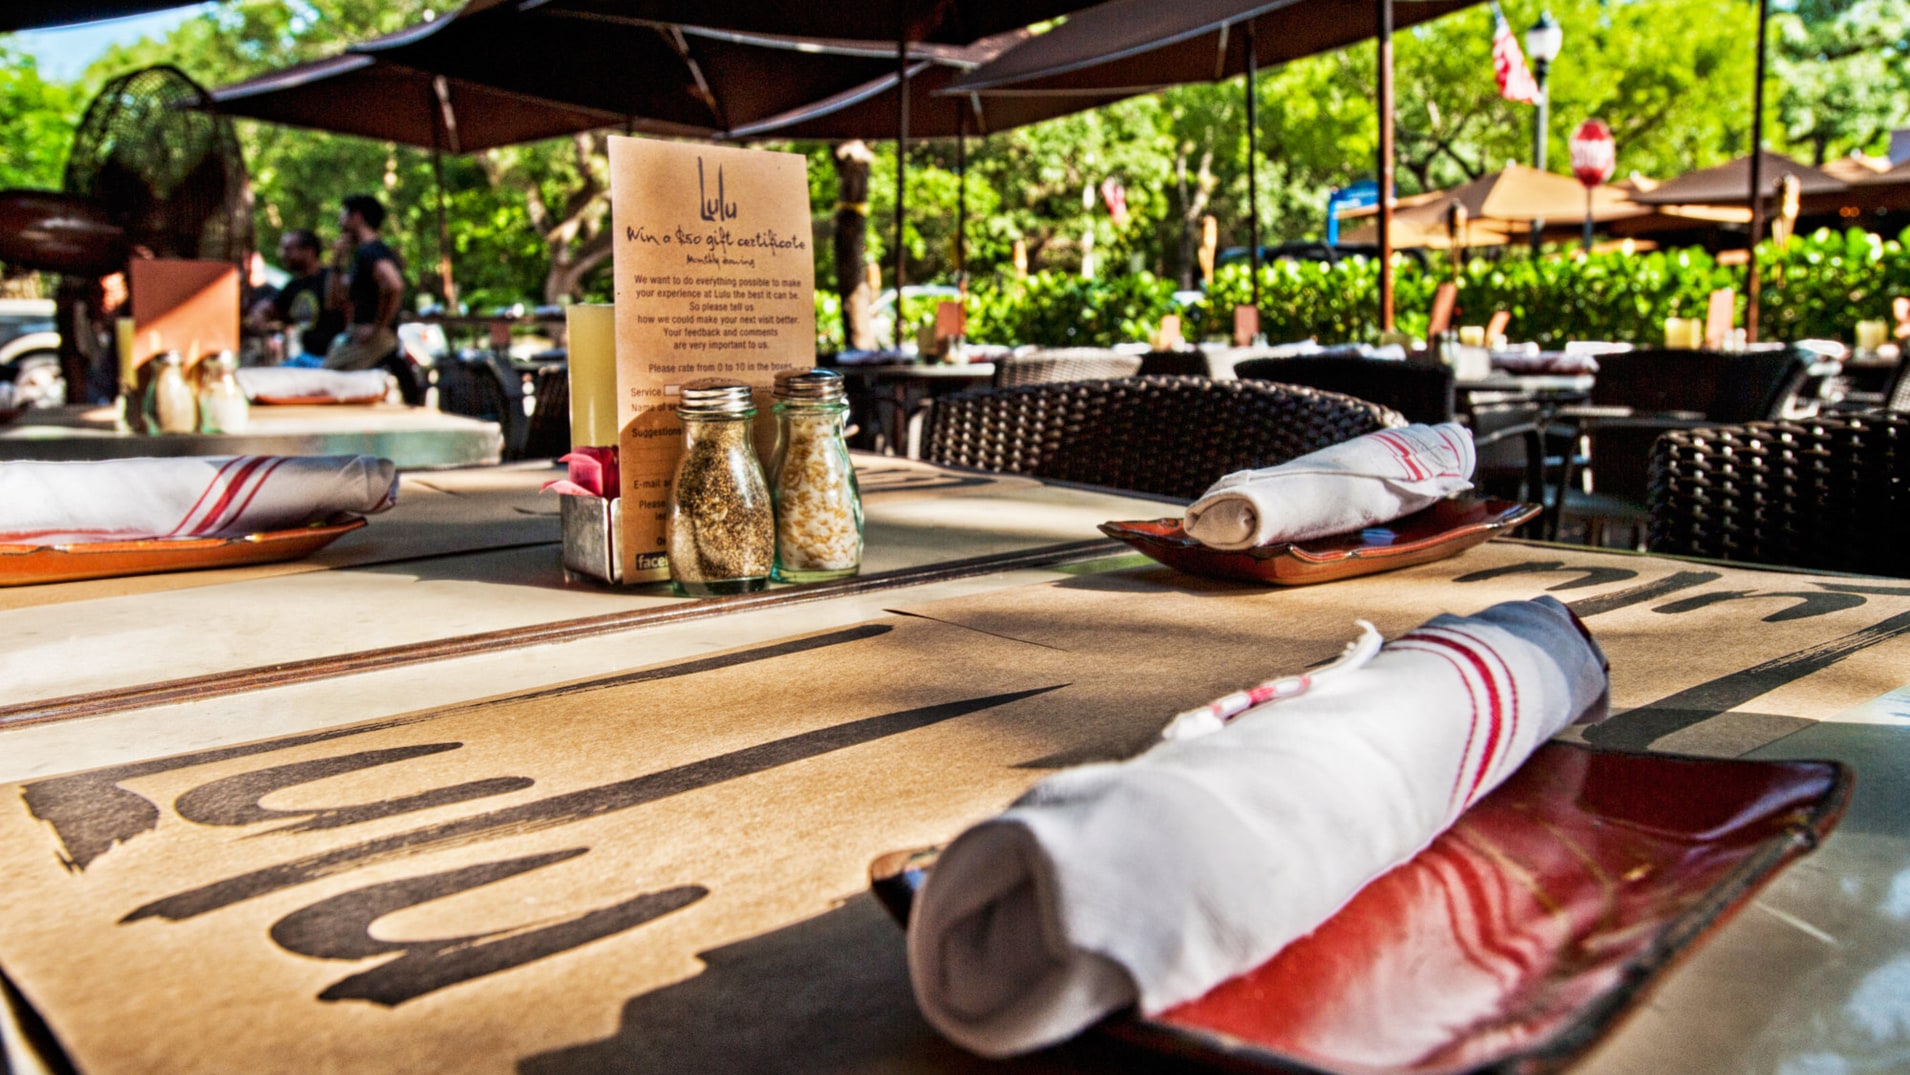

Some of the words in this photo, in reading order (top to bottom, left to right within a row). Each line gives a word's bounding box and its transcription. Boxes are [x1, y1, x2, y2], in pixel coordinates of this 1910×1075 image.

[697, 156, 737, 222] Lulu
[627, 226, 660, 246] Win
[675, 225, 701, 246] $50
[706, 226, 734, 254] gift
[634, 275, 647, 284] We
[650, 276, 670, 285] want
[673, 276, 681, 285] to
[683, 276, 694, 285] do
[696, 276, 736, 288] everything
[739, 277, 770, 288] possible
[772, 278, 780, 287] to
[781, 278, 801, 288] make
[636, 290, 654, 299] your
[657, 289, 702, 299] experience
[704, 290, 712, 298] at
[714, 290, 731, 299] Lulu
[733, 290, 746, 299] the
[747, 290, 764, 299] best
[766, 290, 772, 299] it
[774, 291, 787, 300] can
[689, 301, 700, 311] So
[702, 302, 728, 312] please
[729, 302, 742, 311] tell
[744, 303, 754, 312] us
[637, 315, 655, 324] how
[658, 316, 670, 324] we
[672, 315, 695, 324] could
[696, 315, 718, 324] make
[720, 316, 738, 326] your
[740, 316, 756, 324] next
[758, 315, 774, 324] visit
[664, 327, 682, 336] Your
[684, 327, 720, 337] feedback
[722, 328, 738, 337] and
[739, 328, 779, 337] comments
[673, 341, 687, 350] are
[689, 341, 706, 352] very
[708, 340, 746, 351] important
[748, 340, 756, 349] to
[648, 363, 676, 373] Please
[678, 363, 695, 373] rate
[696, 363, 715, 373] from
[717, 362, 724, 372] 0
[725, 362, 733, 372] to
[735, 362, 746, 372] 10
[748, 362, 755, 371] in
[757, 362, 769, 371] the
[630, 387, 662, 397] Service
[634, 479, 660, 490] E-mail
[639, 500, 667, 511] Please
[20, 624, 1071, 1007] Lulu
